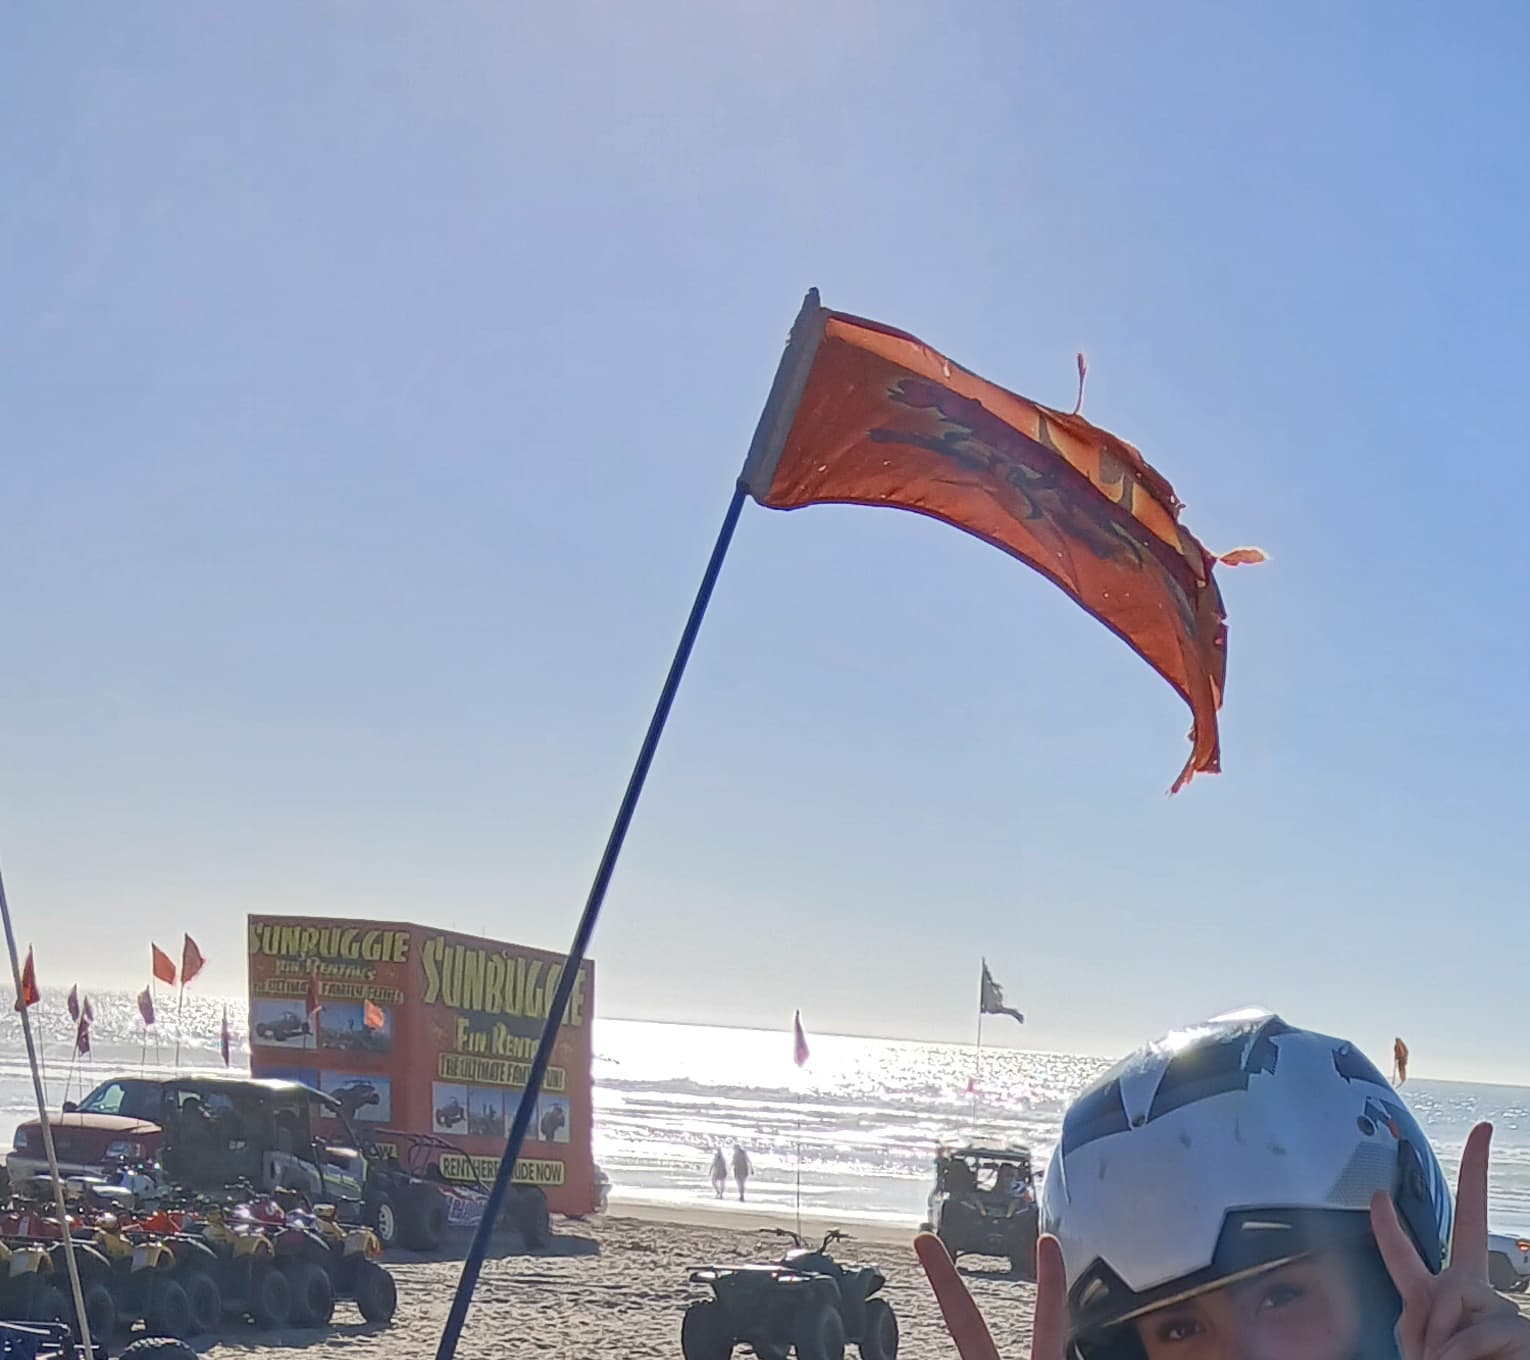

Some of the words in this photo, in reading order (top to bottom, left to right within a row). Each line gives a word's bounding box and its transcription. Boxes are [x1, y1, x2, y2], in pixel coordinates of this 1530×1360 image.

[442, 1156, 471, 1177] RENT
[512, 1161, 534, 1181] IDE
[535, 1162, 562, 1182] NOW
